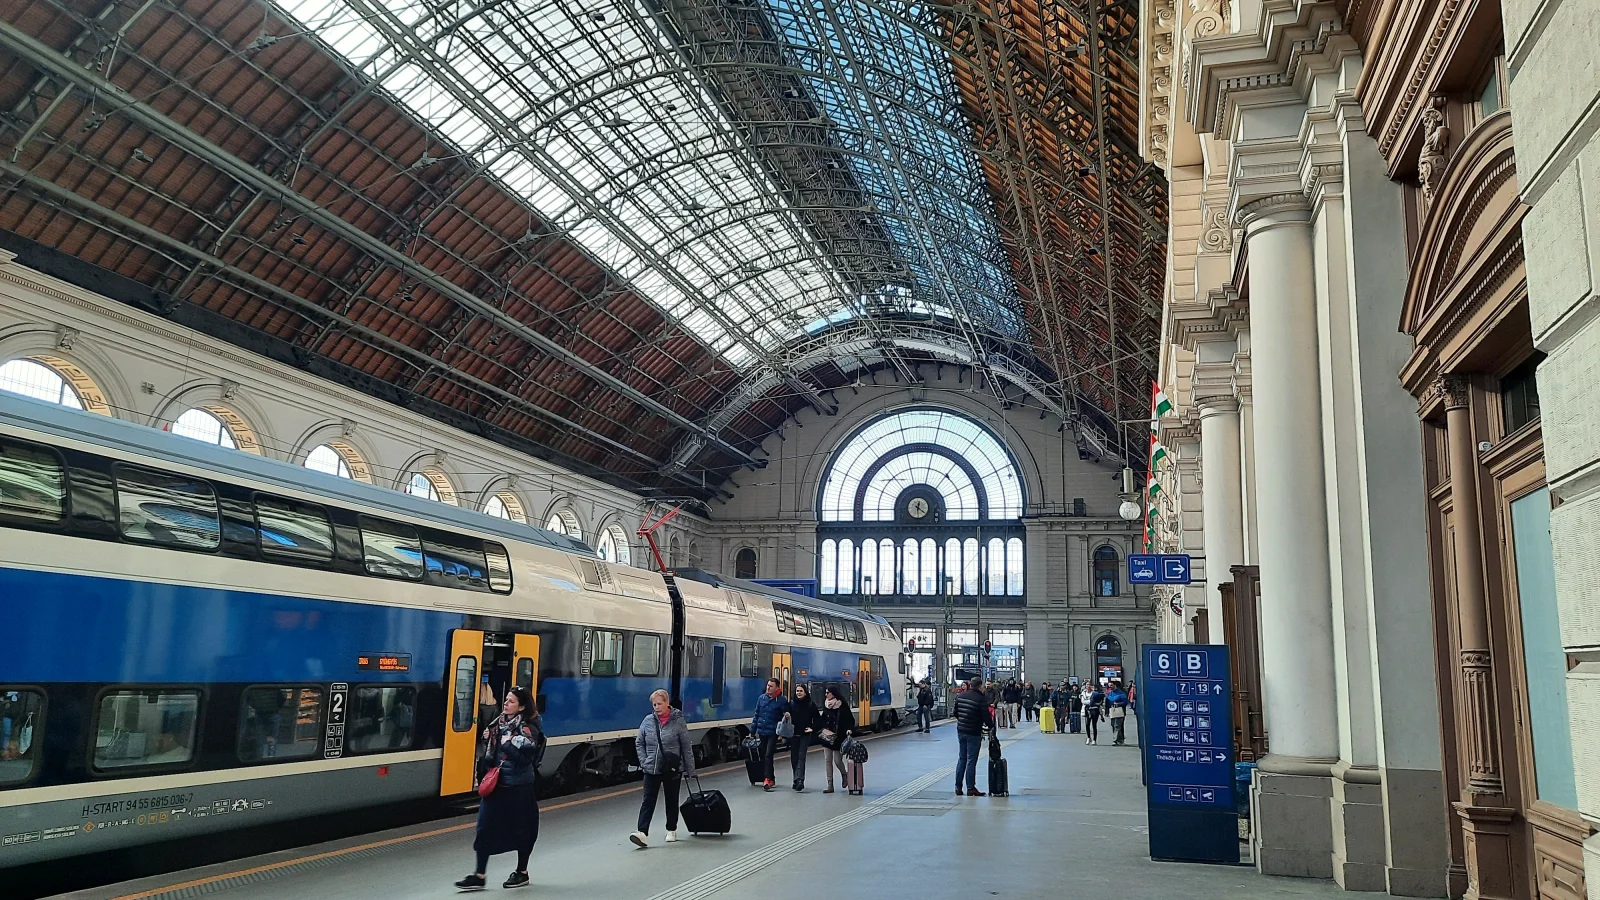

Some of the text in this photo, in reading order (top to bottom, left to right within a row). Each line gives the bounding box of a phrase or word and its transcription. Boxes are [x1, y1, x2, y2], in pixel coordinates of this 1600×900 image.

[584, 630, 590, 644] 2
[1158, 654, 1170, 670] 6
[1187, 654, 1201, 670] B
[332, 693, 343, 712] 2
[1186, 750, 1194, 760] P
[82, 792, 194, 816] H-START 94 55 6815 036-7
